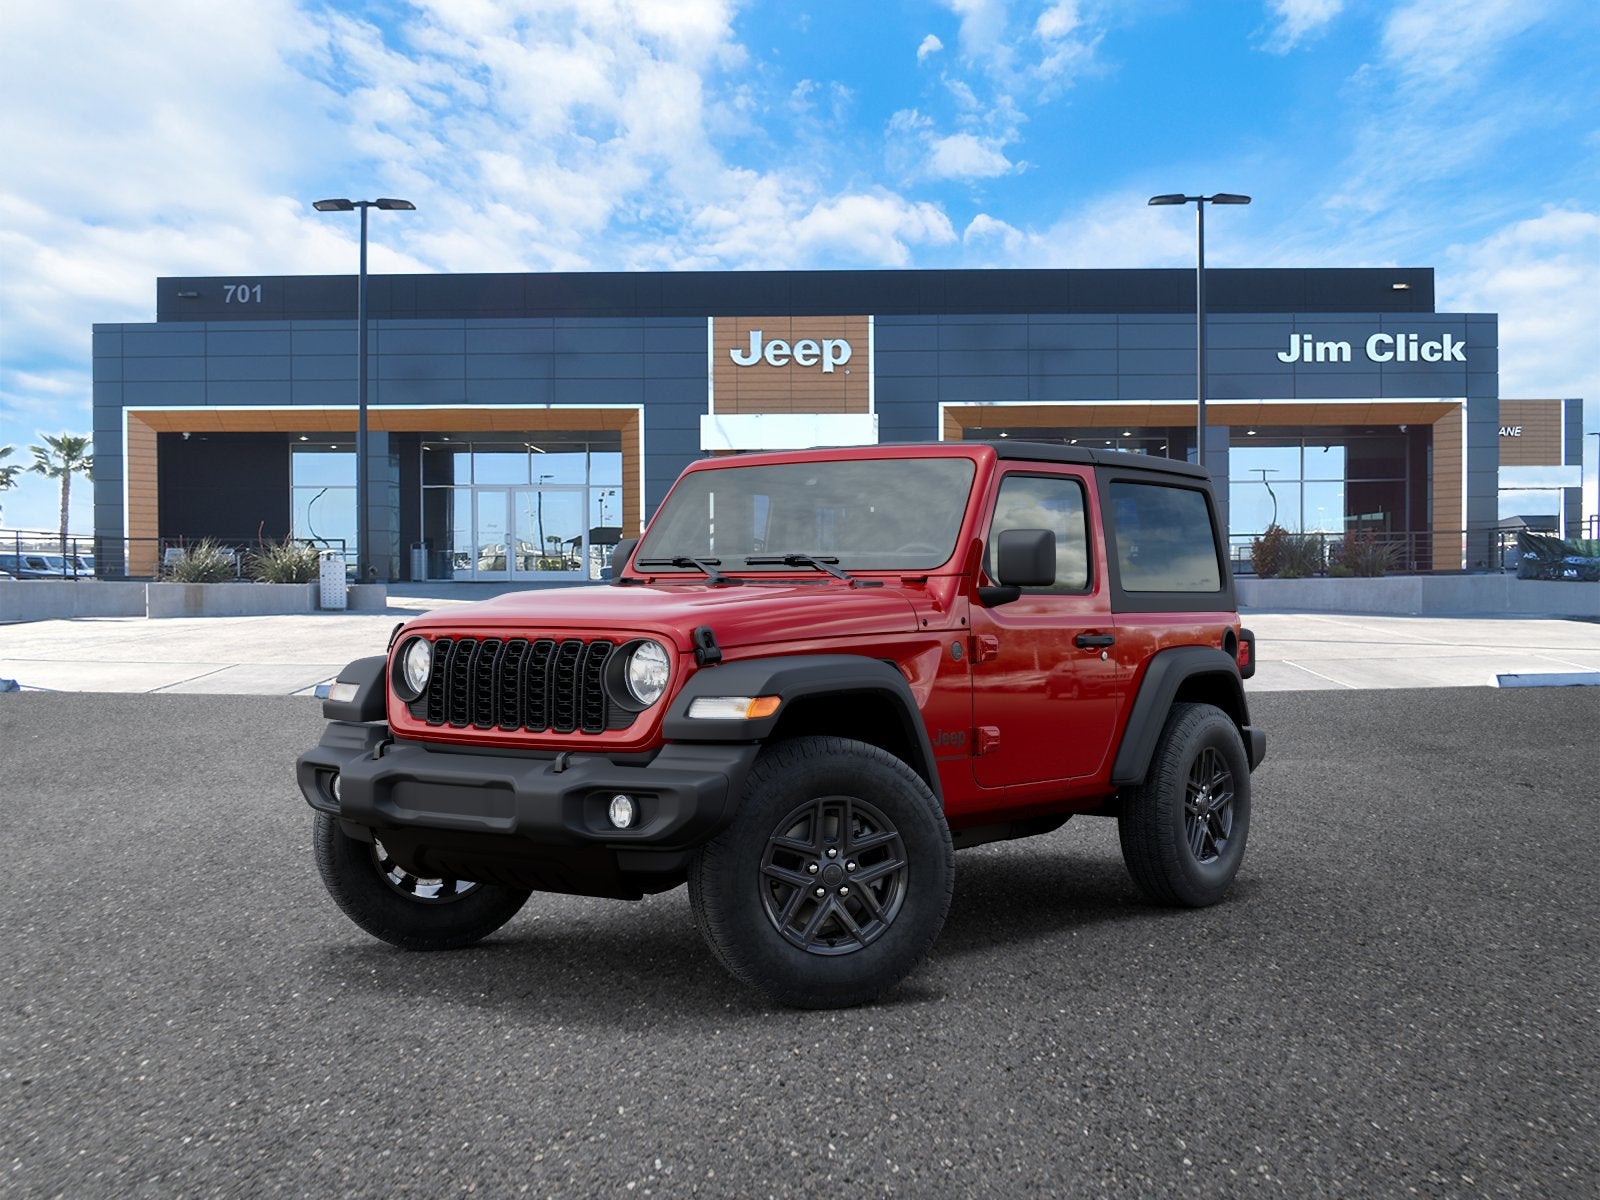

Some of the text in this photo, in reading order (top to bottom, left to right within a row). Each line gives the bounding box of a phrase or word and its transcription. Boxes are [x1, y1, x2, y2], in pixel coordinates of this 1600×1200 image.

[223, 284, 262, 304] 701
[729, 330, 852, 373] Jeep
[1277, 333, 1467, 363] Jim Click
[1498, 426, 1523, 437] ANE
[932, 728, 966, 749] Jeep
